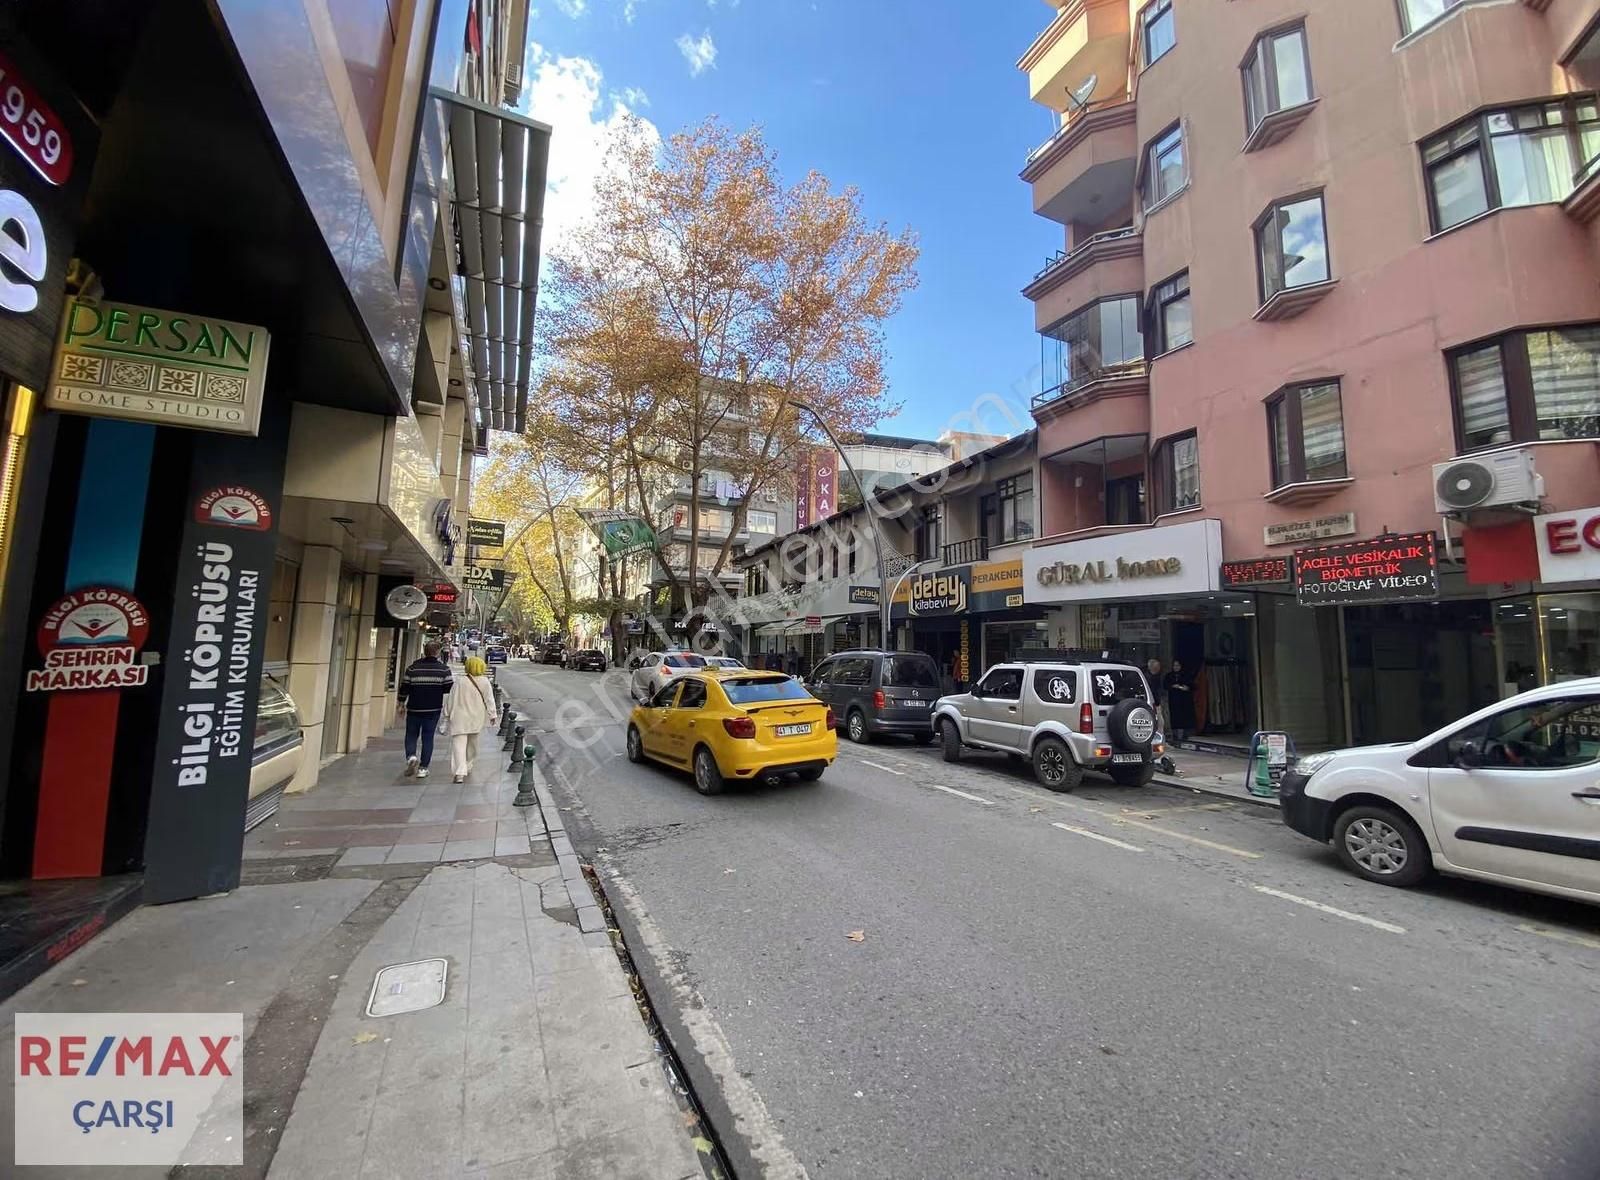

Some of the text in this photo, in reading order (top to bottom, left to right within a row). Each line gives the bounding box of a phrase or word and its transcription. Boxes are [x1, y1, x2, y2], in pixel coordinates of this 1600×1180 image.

[0, 68, 62, 166] 959
[64, 302, 255, 364] PERSAN
[55, 387, 241, 422] HOME STUDIO
[1036, 556, 1182, 586] GÜRAL home
[1303, 546, 1424, 570] ACELE VESİKALIK
[1321, 562, 1402, 581] BİOMETRİK
[913, 573, 960, 606] detay
[1304, 575, 1428, 595] FOTOĞRAF VİDEO
[83, 589, 148, 627] KÖPRÜSÜ
[914, 597, 948, 610] kitabevi
[29, 667, 147, 690] MARKASI
[172, 541, 233, 787] BİLGİ KÖPRÜSÜ
[214, 569, 259, 757] EĞİTİM KURUMLARI
[779, 726, 786, 735] 41
